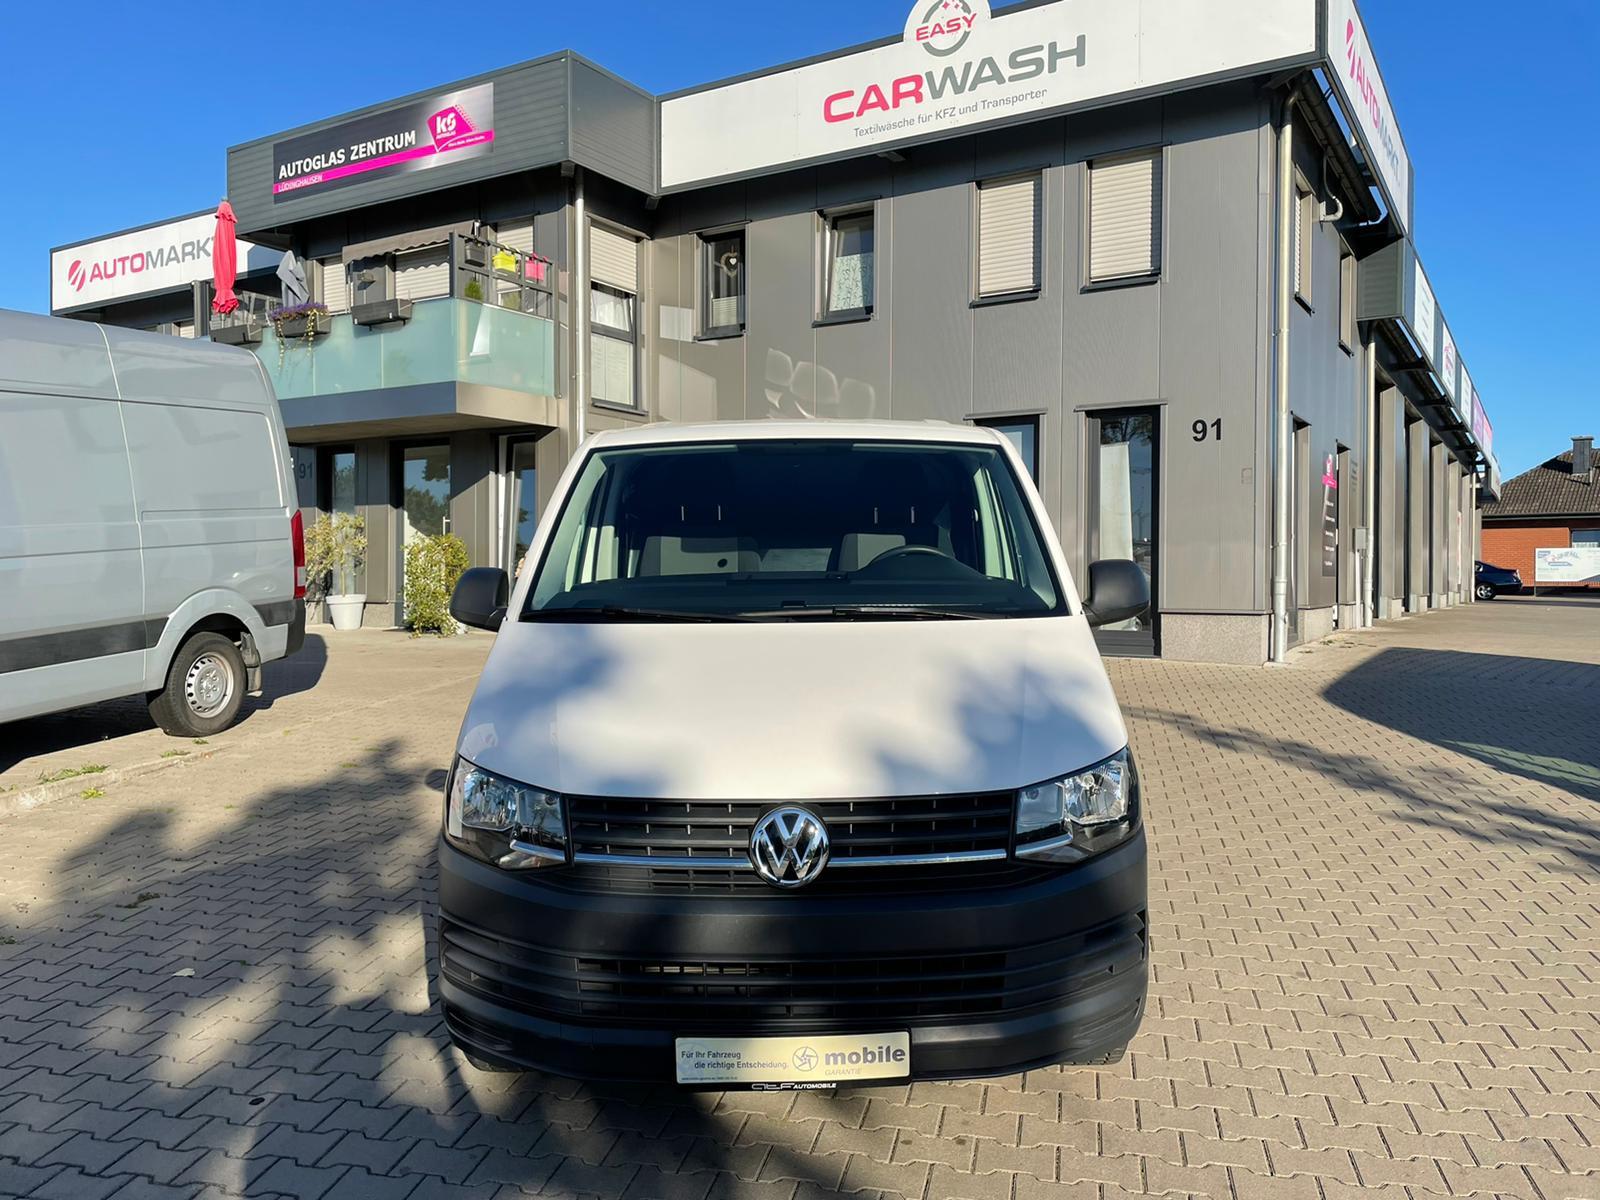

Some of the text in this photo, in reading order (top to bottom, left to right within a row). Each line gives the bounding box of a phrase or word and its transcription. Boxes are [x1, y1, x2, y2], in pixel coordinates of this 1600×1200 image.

[916, 13, 977, 41] EASY
[823, 34, 1086, 123] CARWASH
[935, 107, 956, 120] KFZ
[958, 102, 978, 115] und
[981, 89, 1048, 109] Transporter
[278, 130, 416, 180] AUTOGLAS ZENTRUM
[89, 236, 215, 283] AUTOMARK
[1192, 417, 1222, 442] 91
[299, 462, 313, 479] 91
[681, 1050, 741, 1060] Für Ihr Fahrzeug
[694, 1061, 706, 1069] die
[707, 1061, 735, 1070] richtige
[825, 1045, 906, 1066] mobile
[825, 1068, 862, 1076] GARANTIE
[793, 1082, 837, 1090] AUTOMOBILE
